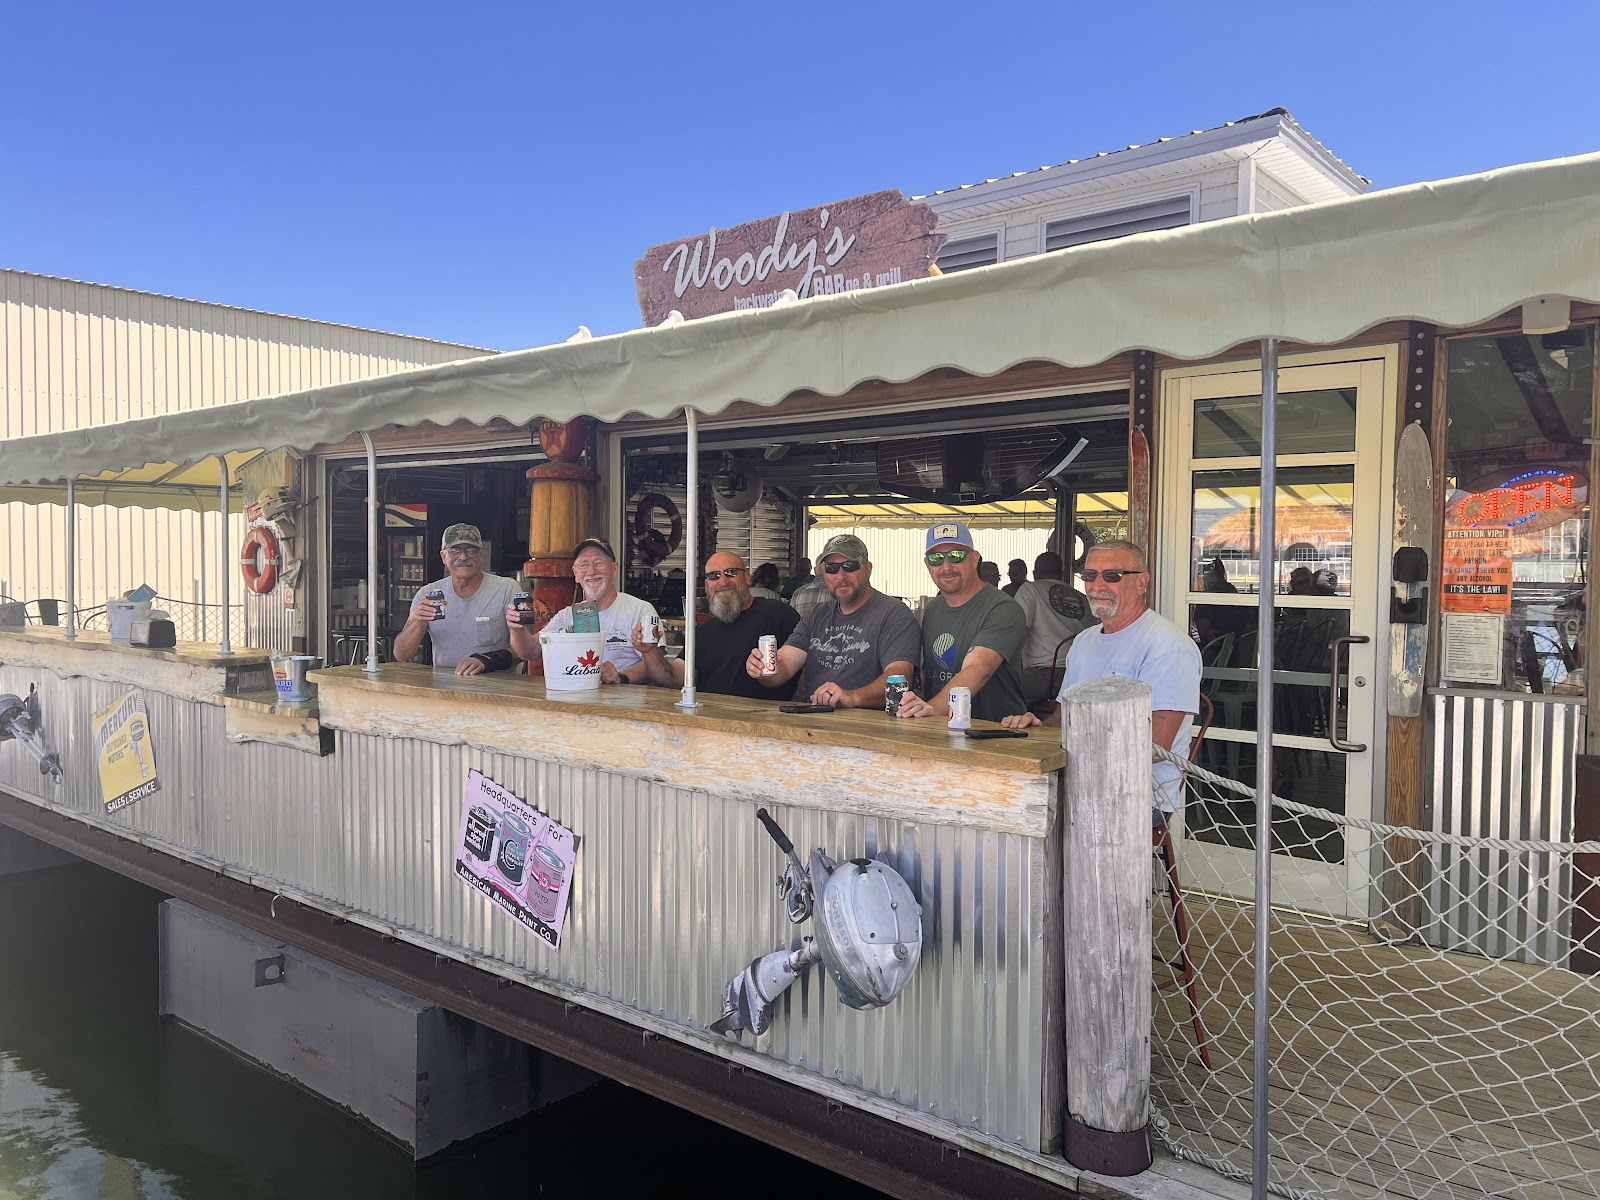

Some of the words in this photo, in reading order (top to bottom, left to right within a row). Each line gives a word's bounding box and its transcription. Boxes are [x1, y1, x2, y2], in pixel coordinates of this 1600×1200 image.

[662, 209, 856, 300] Woody's
[863, 272, 873, 288] &
[876, 266, 902, 286] grill
[1458, 475, 1575, 524] OPEN
[1447, 530, 1485, 538] ATTENTION
[1450, 585, 1464, 593] IT'S
[1467, 585, 1480, 593] THE
[1482, 585, 1501, 594] LAW!
[766, 644, 776, 672] Coors
[100, 693, 138, 747] MERCURY
[106, 734, 127, 753] OUTBOARD
[107, 749, 124, 766] MOTORS
[107, 795, 126, 813] SALES
[128, 781, 156, 802] SERVICE
[480, 781, 538, 826] Headquarters
[548, 825, 564, 842] For
[459, 867, 491, 896] AMERICAN
[493, 890, 516, 915] MARINE
[519, 911, 538, 930] PAINT
[831, 895, 854, 954] OHNSON
